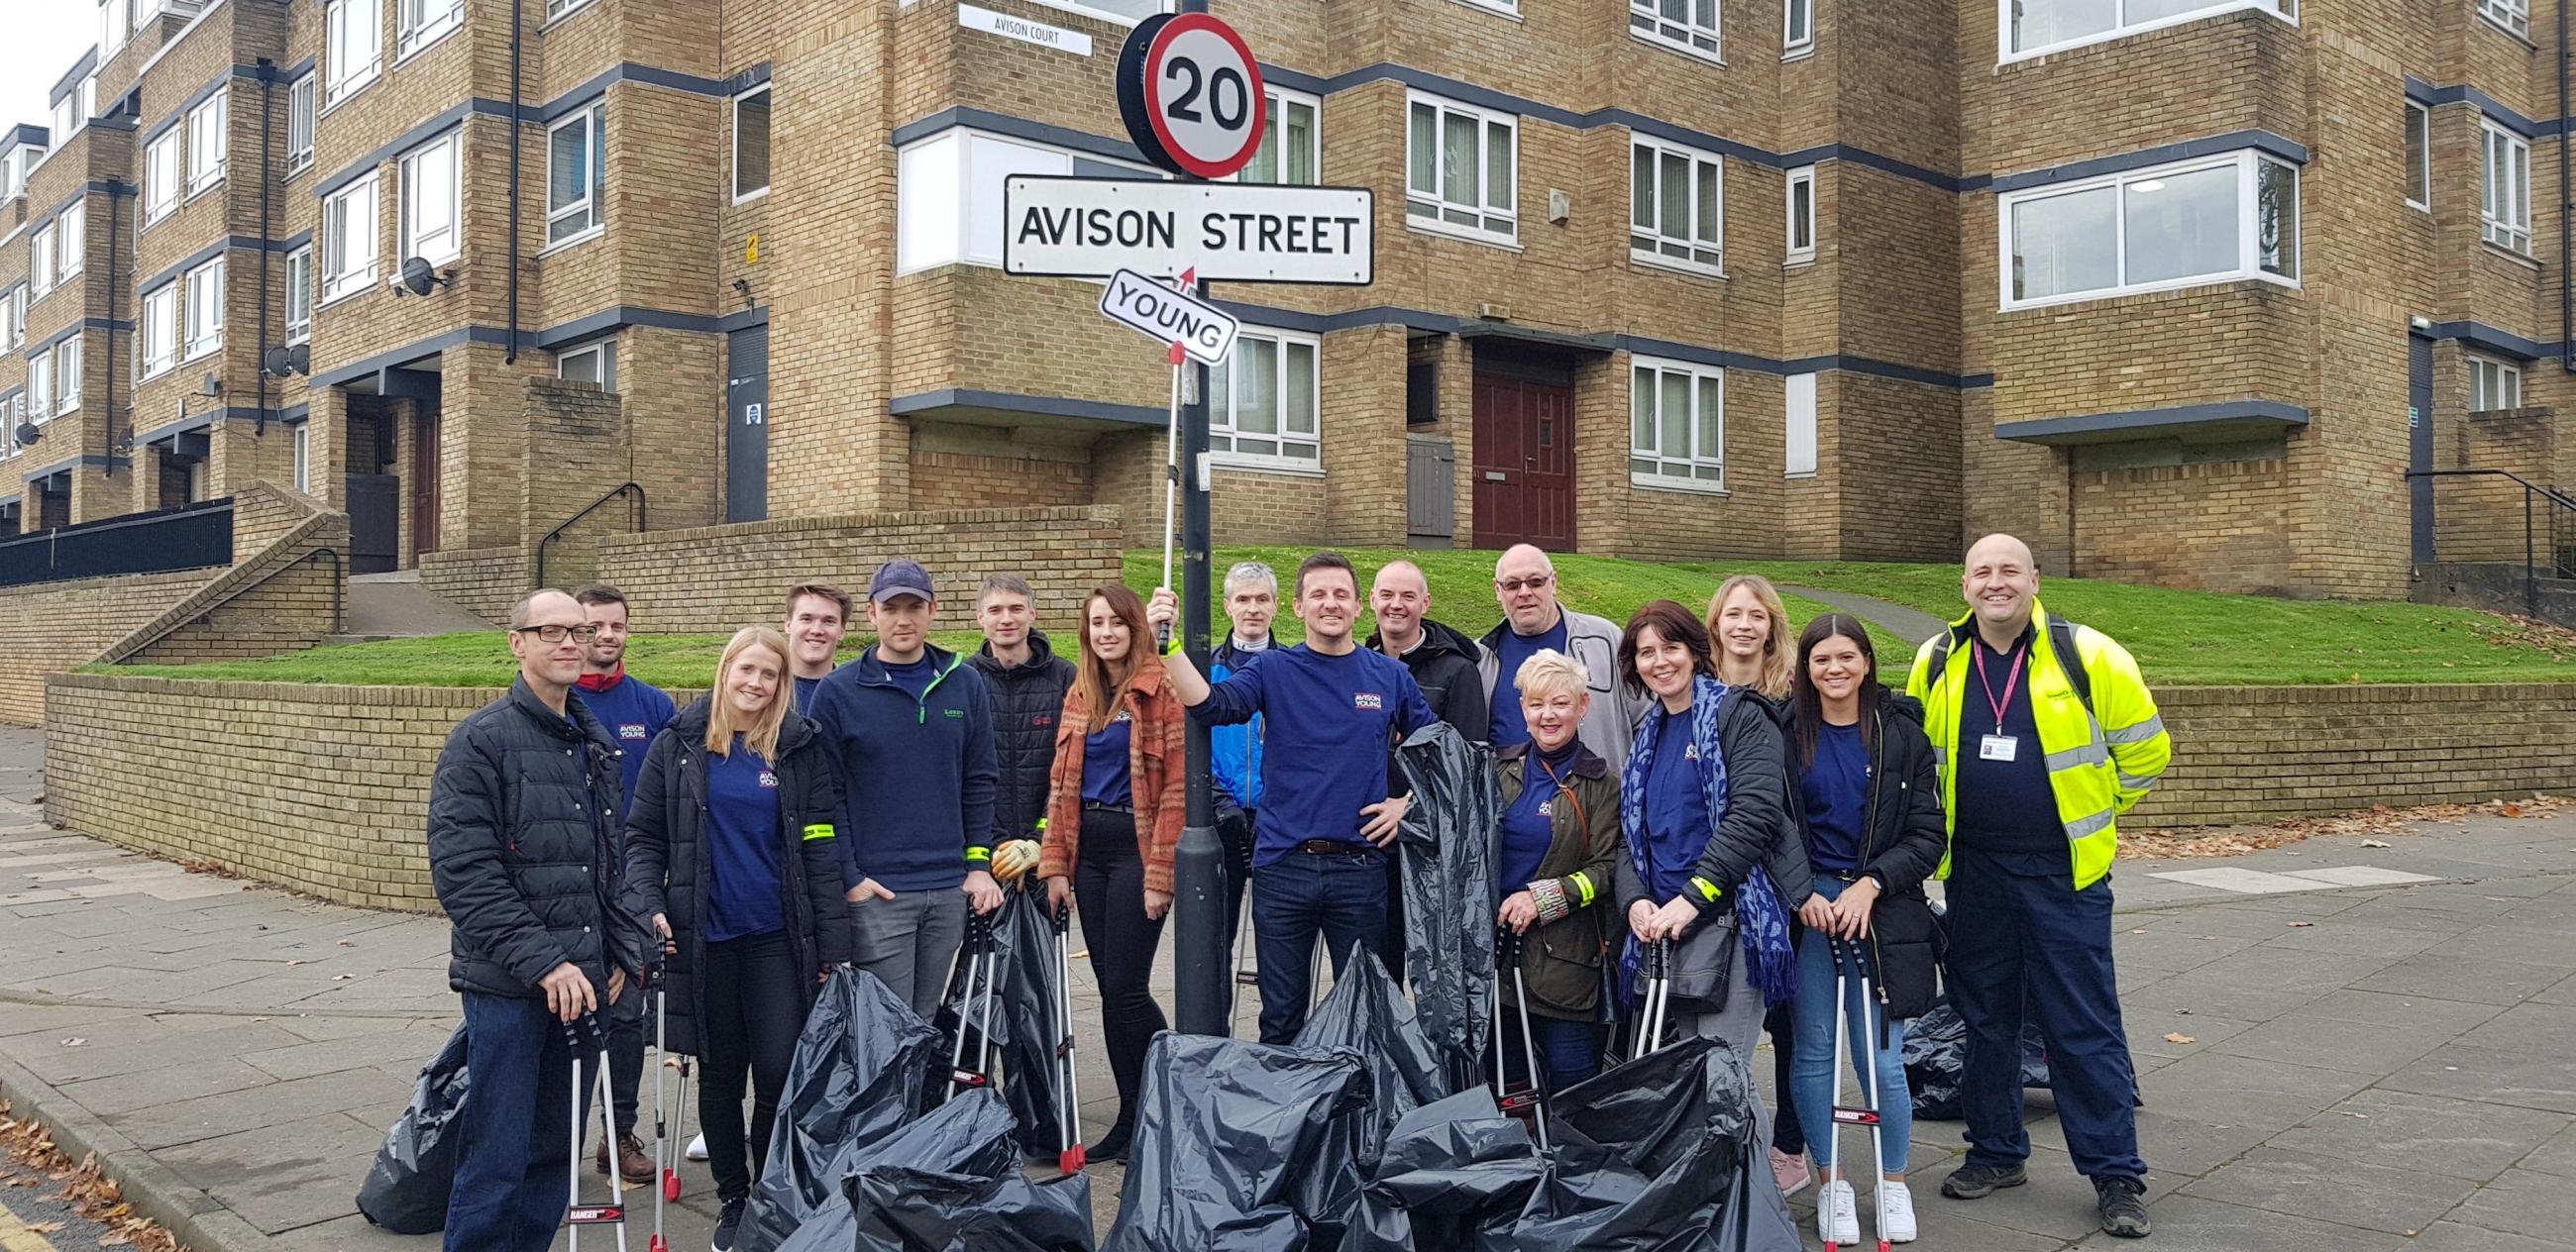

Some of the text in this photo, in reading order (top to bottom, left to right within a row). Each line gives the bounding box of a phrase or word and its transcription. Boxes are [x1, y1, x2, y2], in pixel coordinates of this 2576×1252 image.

[995, 17, 1060, 45] AVISON COURT
[1166, 55, 1248, 131] 20
[1018, 206, 1360, 256] AVISON STREET
[1119, 280, 1223, 349] YOUNG
